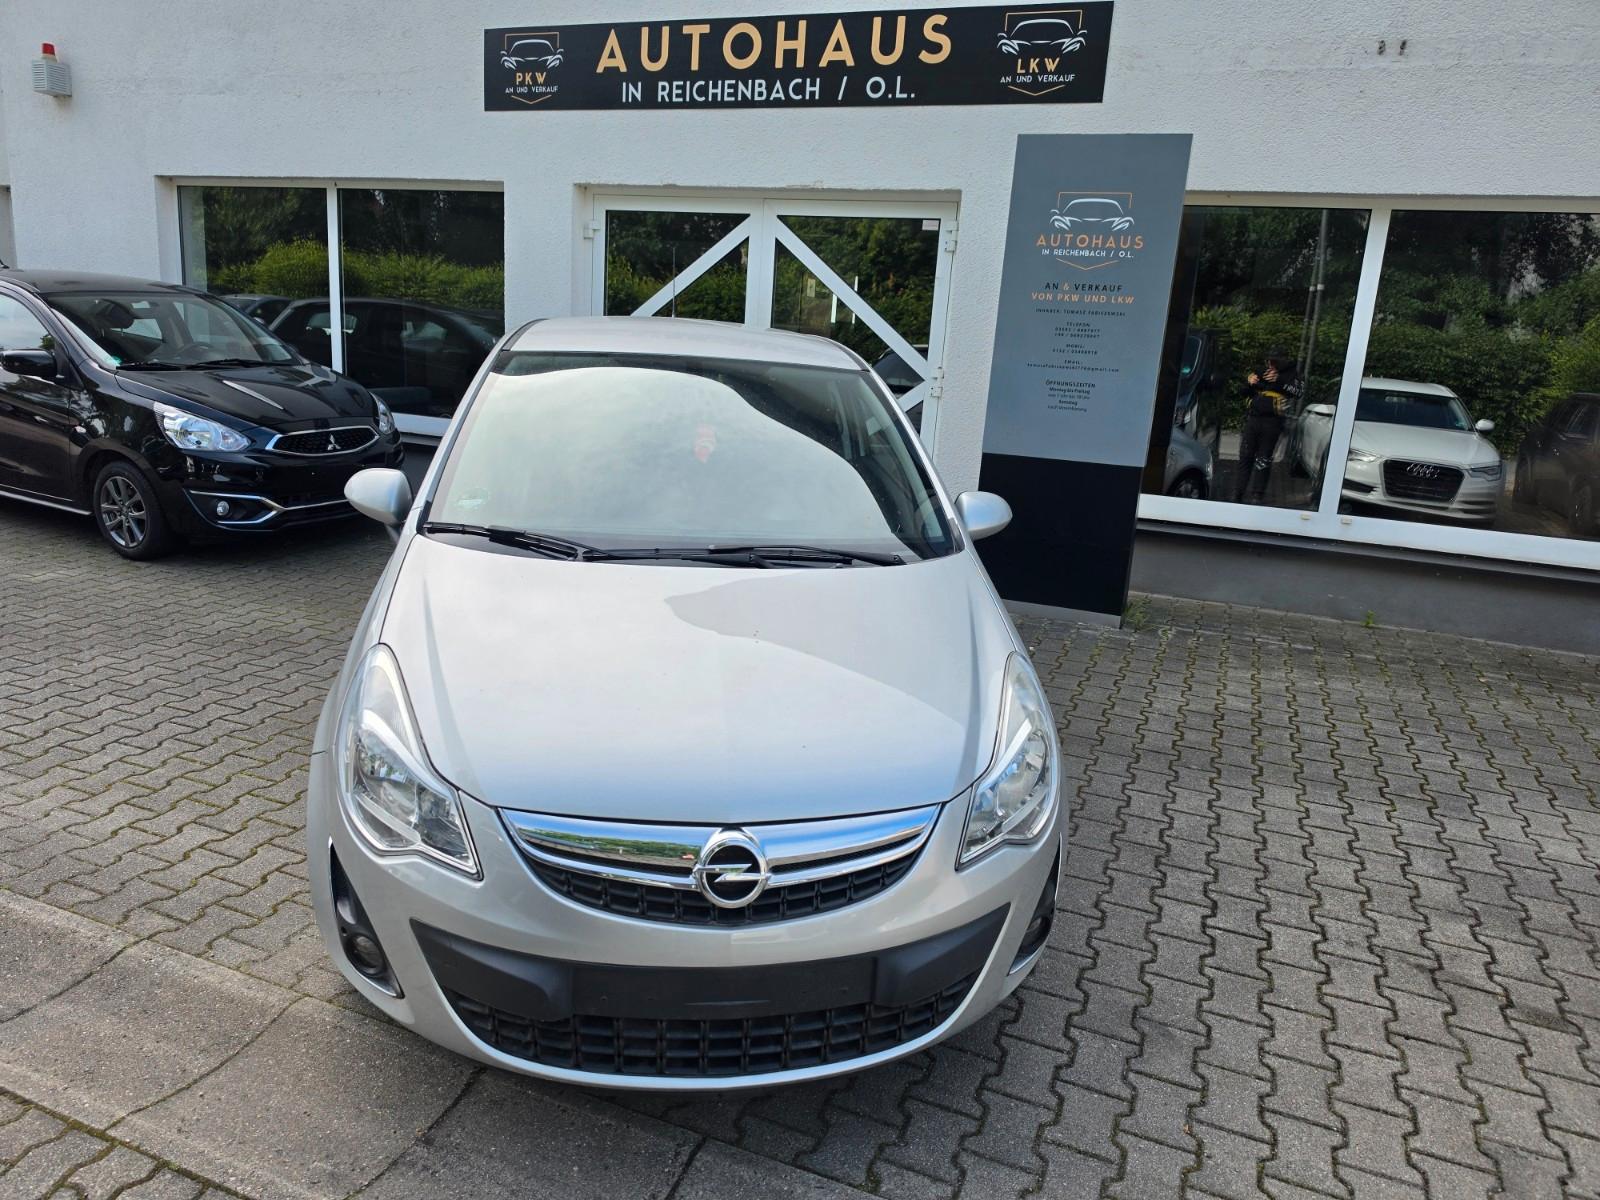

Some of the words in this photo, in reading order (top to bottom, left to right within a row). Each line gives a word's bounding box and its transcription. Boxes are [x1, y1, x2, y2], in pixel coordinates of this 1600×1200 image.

[596, 14, 952, 73] AUTOHAUS
[1016, 57, 1061, 74] LKW
[516, 72, 547, 85] PKW
[1000, 75, 1012, 83] AN
[1016, 75, 1033, 83] UND
[1038, 74, 1076, 83] VERKAUF
[505, 86, 514, 94] AN
[516, 86, 529, 94] UND
[531, 85, 560, 93] VERKAUF
[622, 82, 642, 103] IN
[657, 77, 820, 102] REICHENBACH
[837, 75, 848, 101] /
[866, 75, 916, 99] O.L.
[1036, 233, 1144, 249] AUTOHAUS
[1042, 248, 1050, 256] IN
[1053, 249, 1106, 257] REICHENBACH
[1118, 250, 1135, 258] O.L.
[1045, 282, 1059, 290] AN
[1063, 283, 1070, 291] &
[1074, 283, 1124, 292] VERKAUF
[1031, 292, 1053, 301] VON
[1057, 293, 1080, 303] PKW
[1084, 295, 1107, 303] UND
[1111, 296, 1135, 305] LKW
